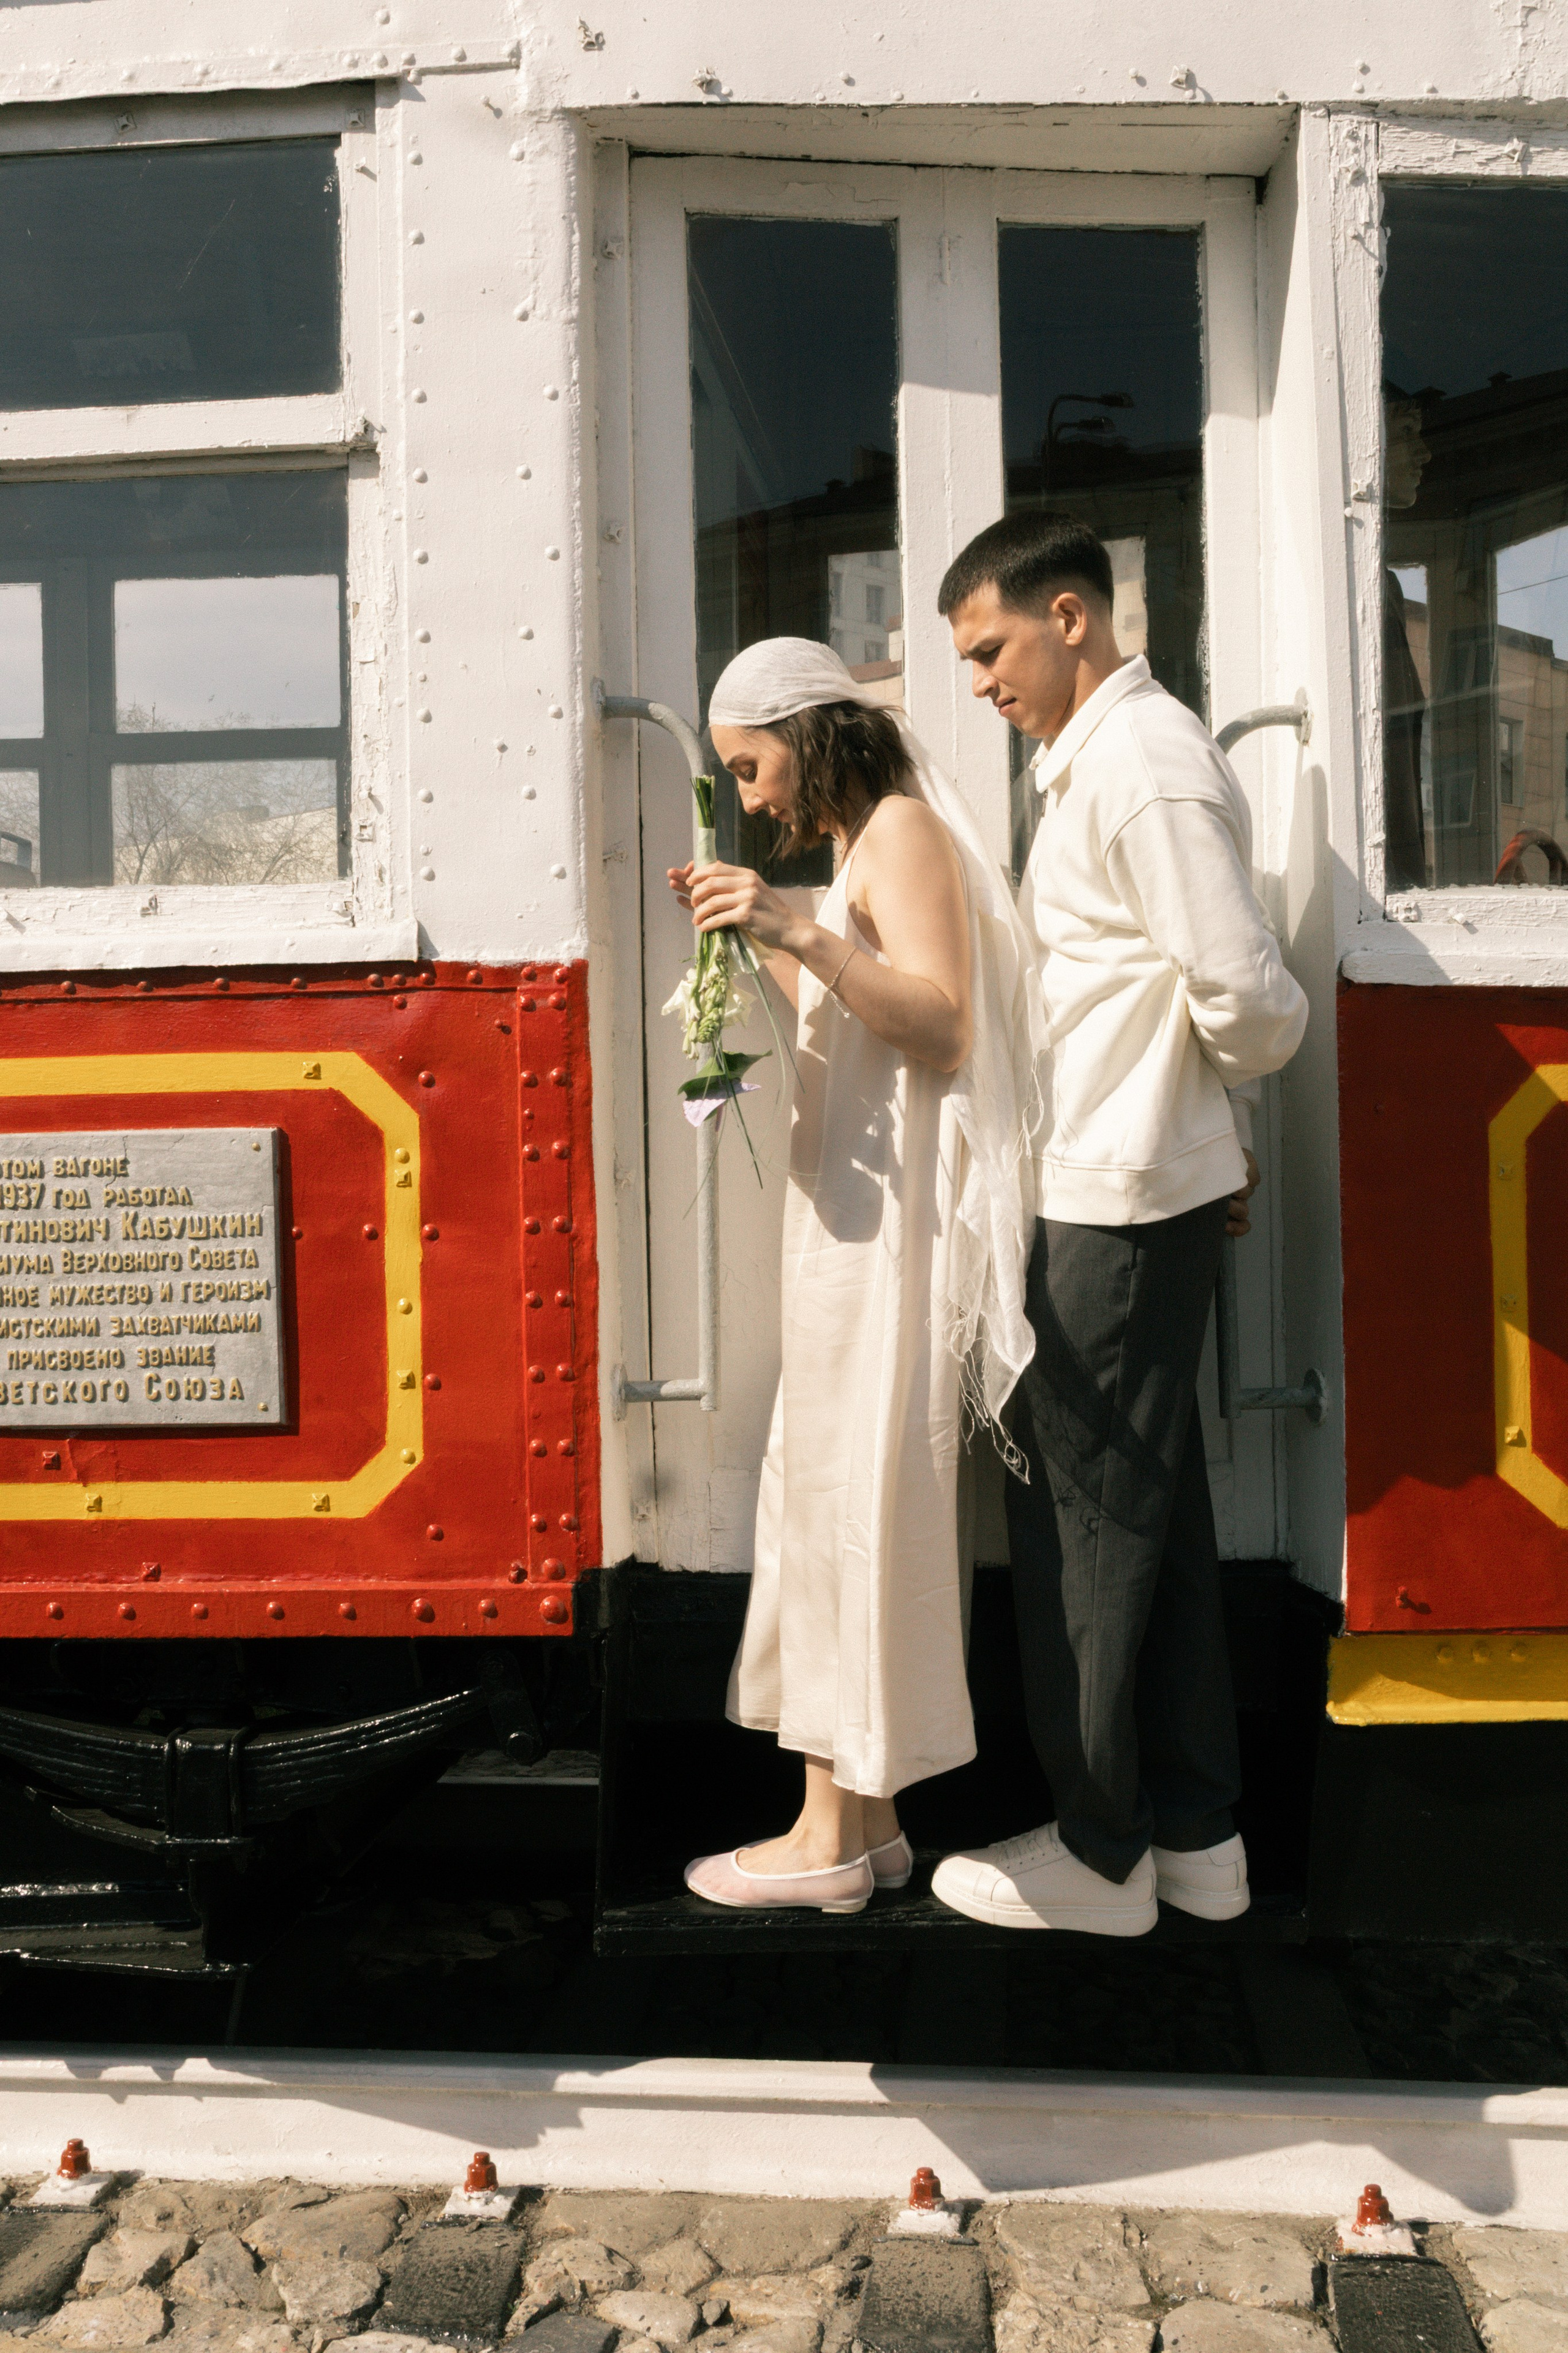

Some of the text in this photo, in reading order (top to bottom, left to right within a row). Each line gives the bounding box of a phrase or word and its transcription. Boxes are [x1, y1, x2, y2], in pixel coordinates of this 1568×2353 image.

[53, 1157, 128, 1177] ВАГОНЕ
[0, 1182, 192, 1209] 937 ГОД РАБОТАЛ
[122, 1210, 262, 1241] КАБУШКИН
[61, 1247, 181, 1274] ВЕРХОВНОГО
[187, 1244, 258, 1269] СОВЕТА
[0, 1278, 269, 1307] НОЕ МУЖЕСТВО И ГЕРОИЗМ
[110, 1312, 260, 1336] ЗАХВАТЧИКАМИ
[7, 1345, 214, 1370] ПРИСВОЕНО ЗВАНИЕ
[144, 1372, 243, 1401] СОЮЗА
